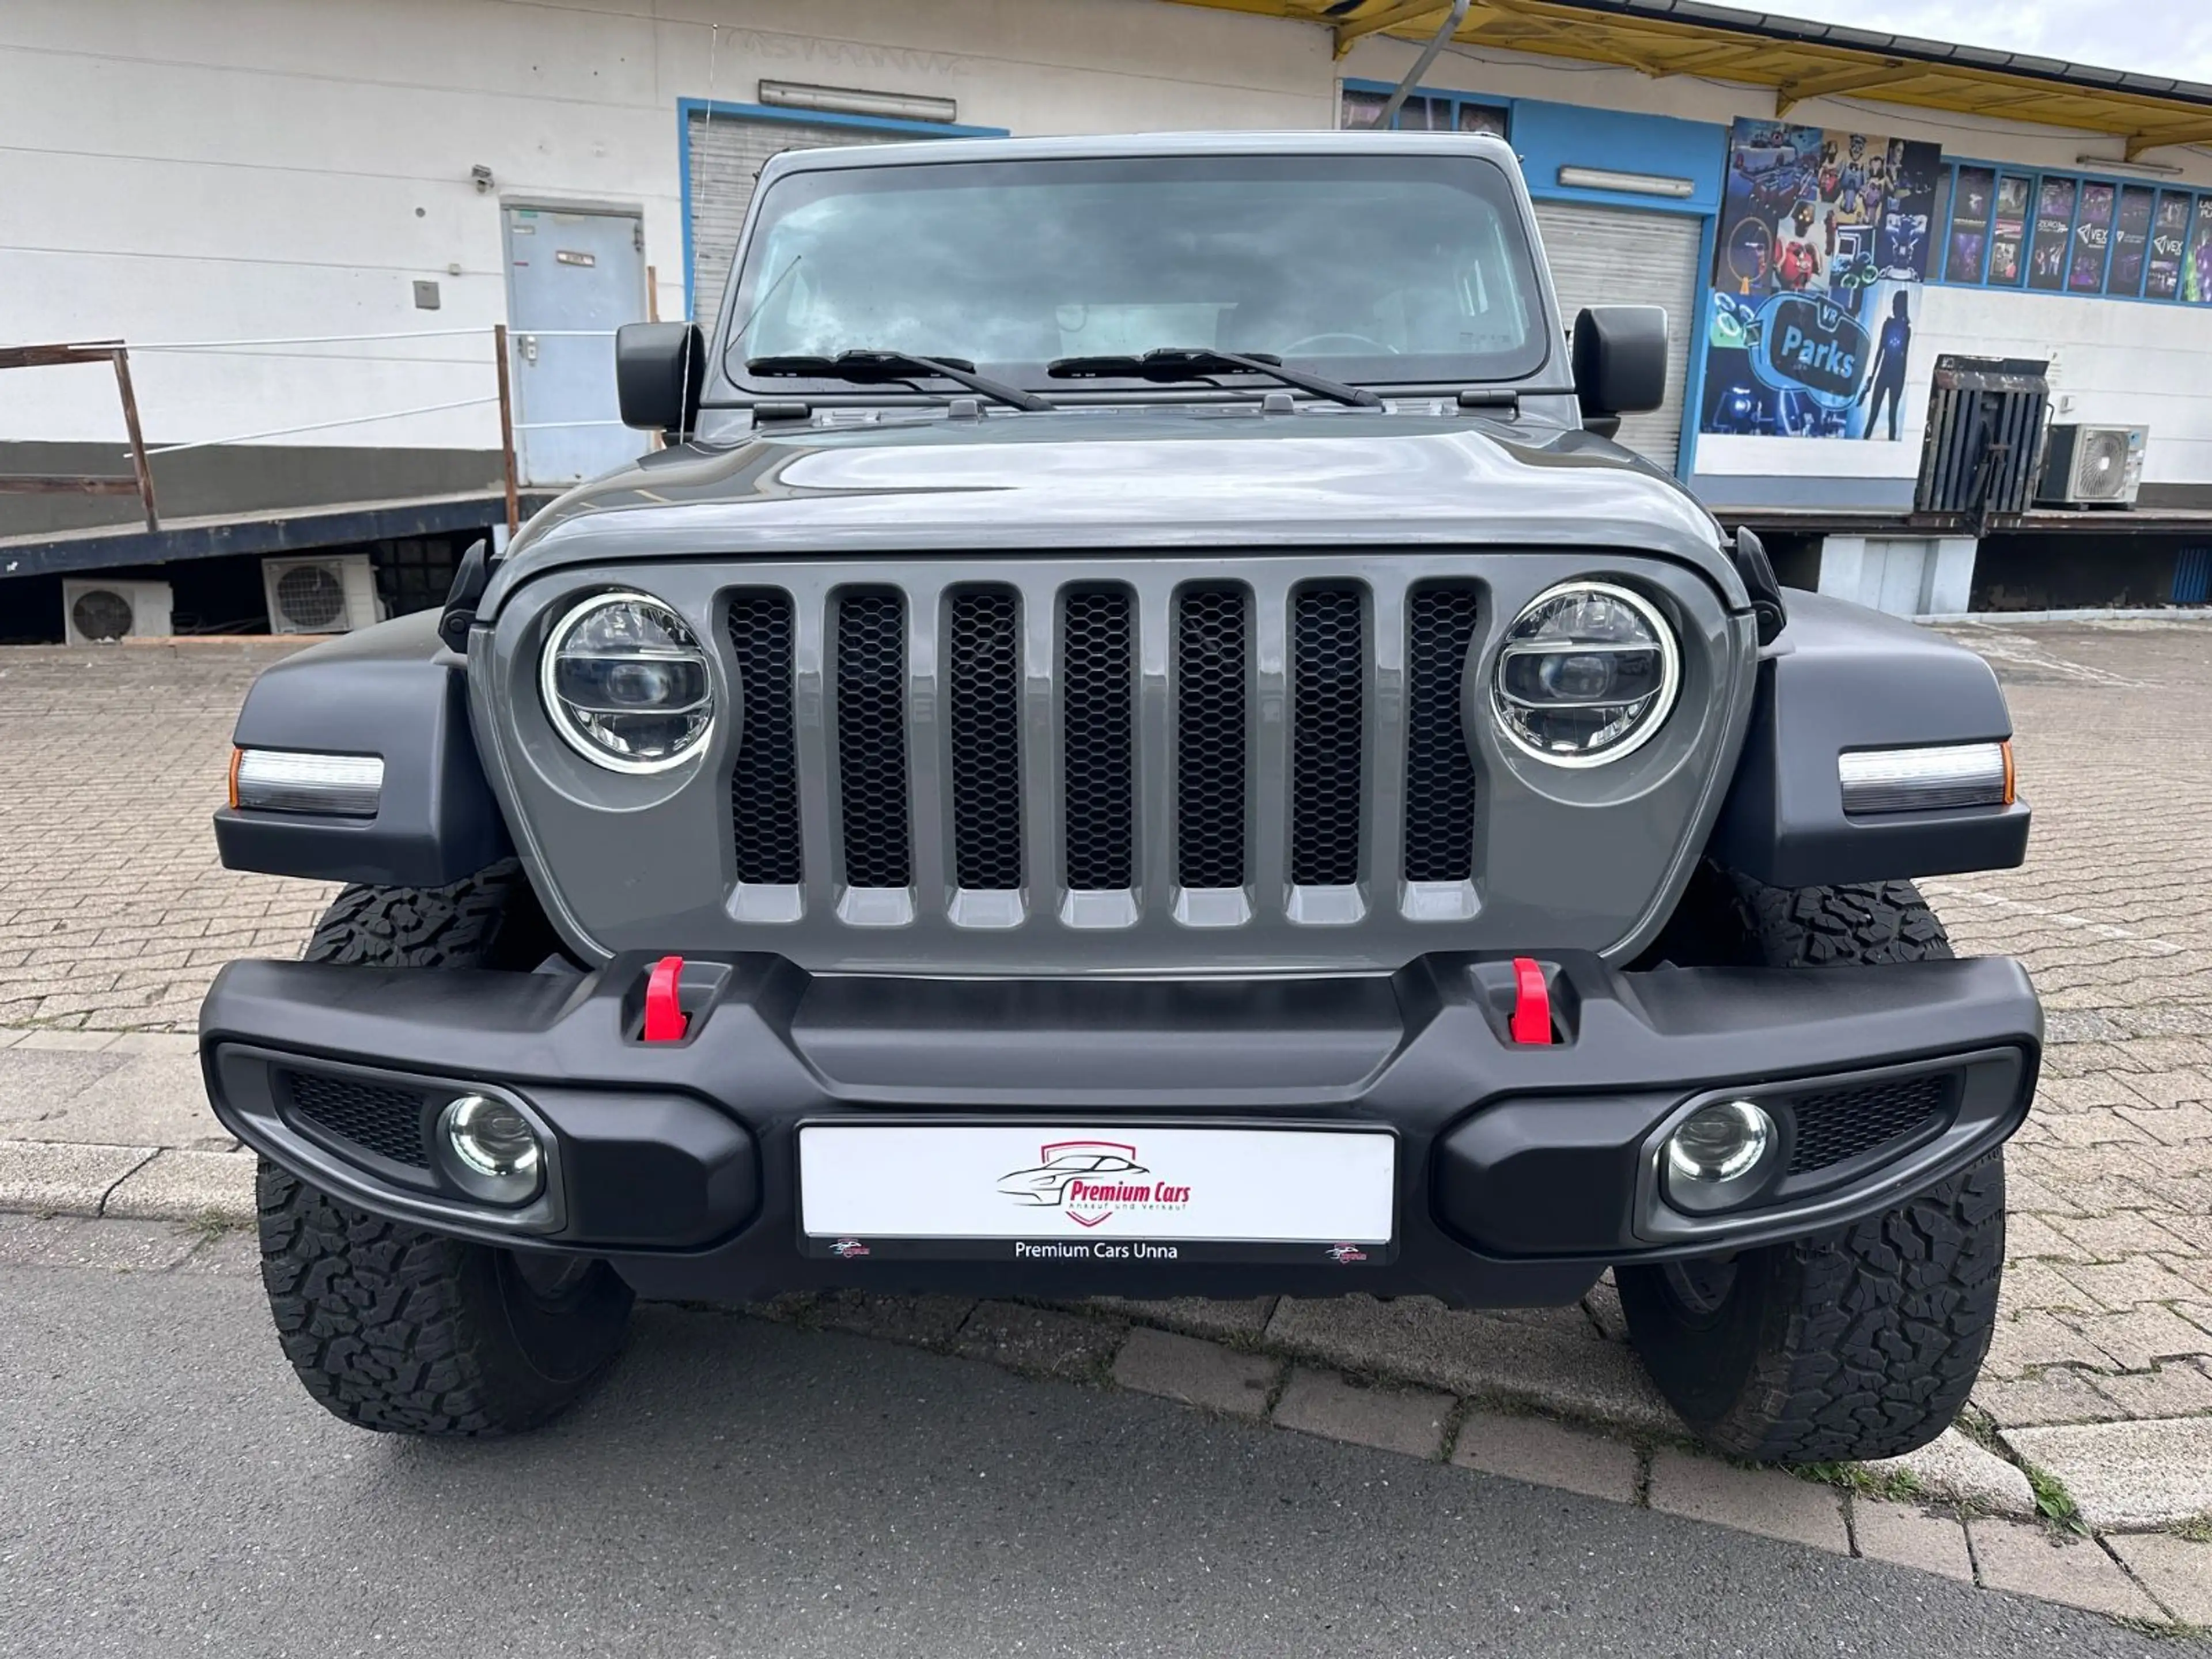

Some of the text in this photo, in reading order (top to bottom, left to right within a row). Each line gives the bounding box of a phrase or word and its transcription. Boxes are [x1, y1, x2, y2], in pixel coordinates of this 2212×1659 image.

[1823, 305, 1838, 323] VR
[1781, 325, 1855, 378] Parks
[1070, 1180, 1191, 1202] Premium Cars
[1016, 1242, 1177, 1258] Premium Cars Unna
